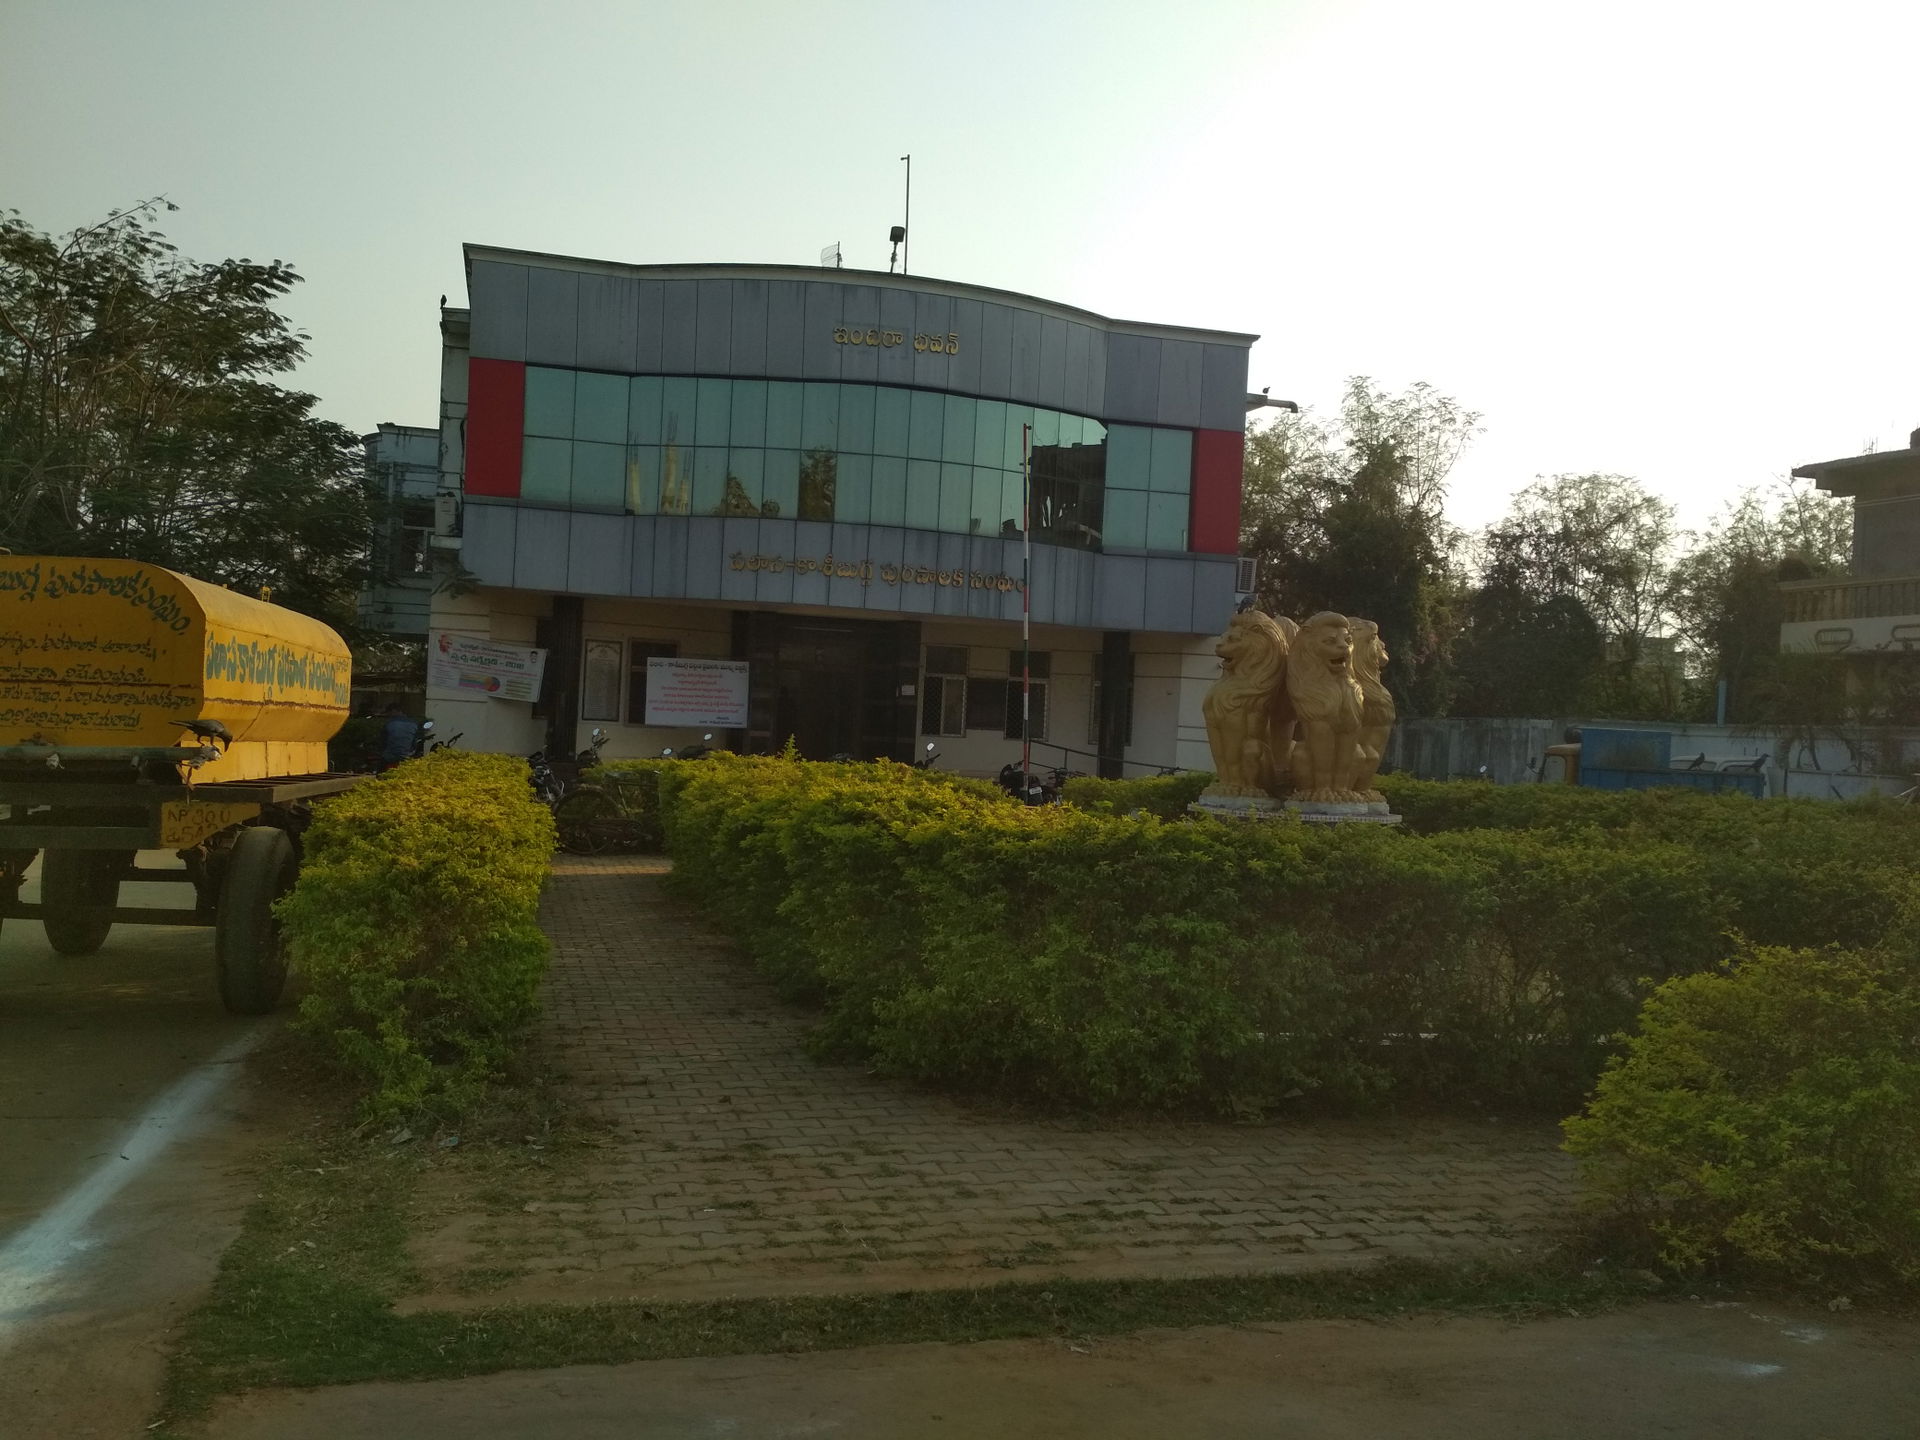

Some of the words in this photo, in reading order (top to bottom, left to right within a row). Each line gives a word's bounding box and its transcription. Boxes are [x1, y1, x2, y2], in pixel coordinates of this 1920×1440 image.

[913, 332, 960, 355] భవన్
[881, 564, 966, 588] పురపాలక
[168, 809, 188, 822] AP
